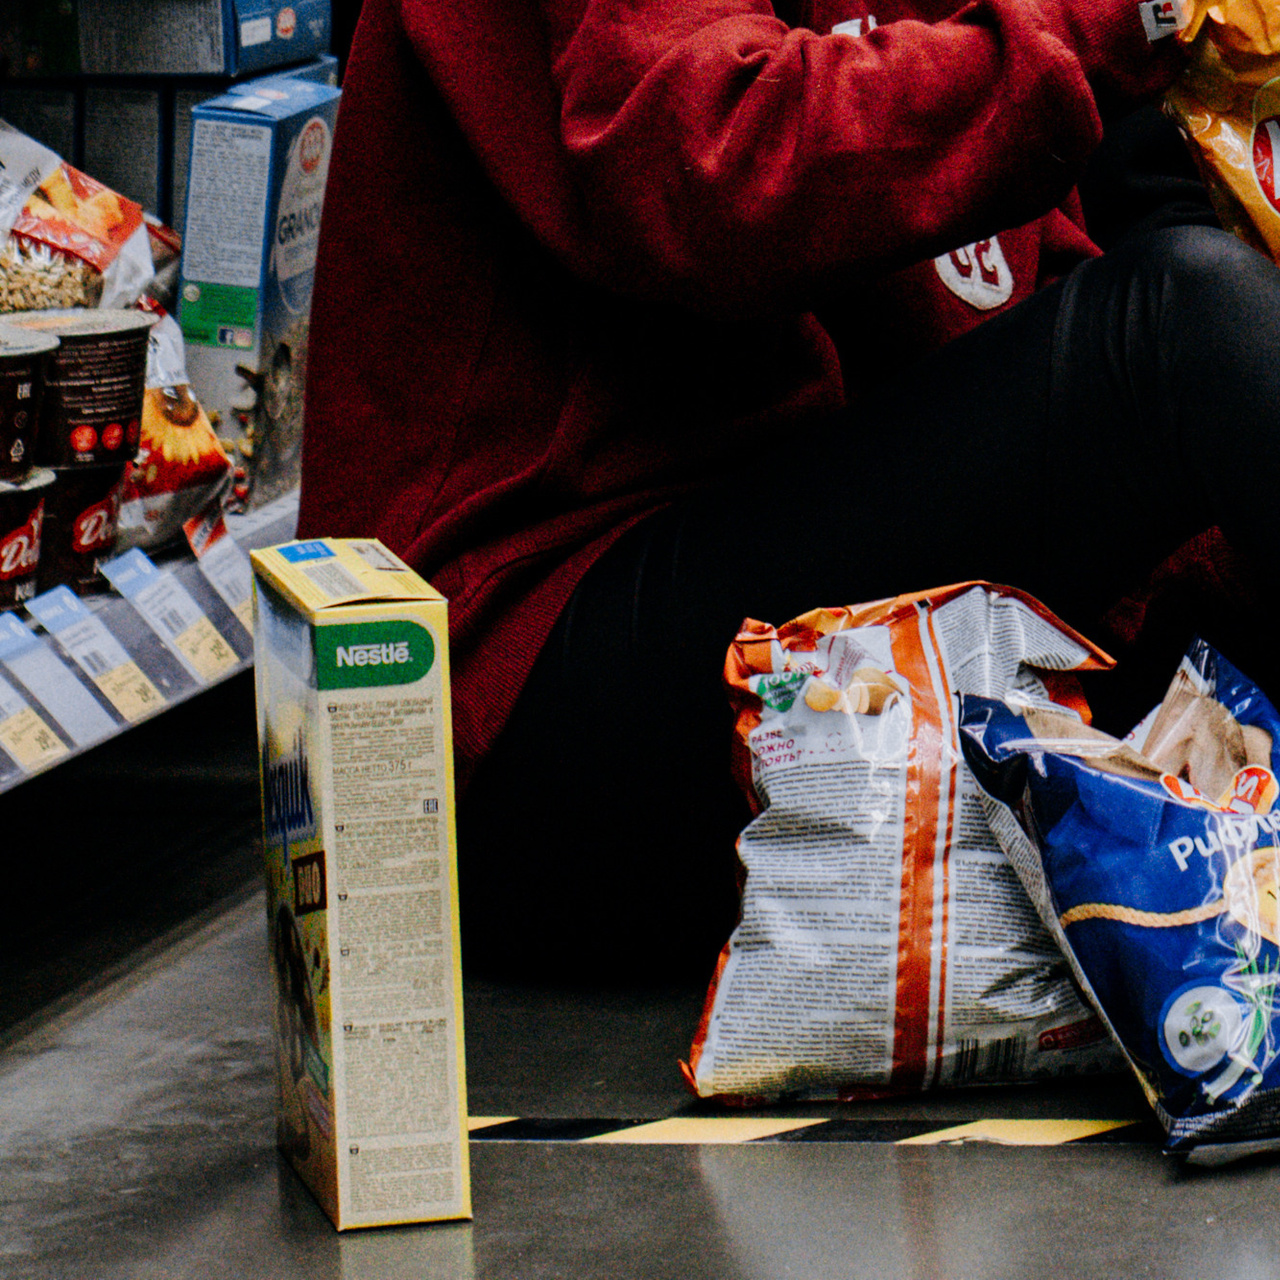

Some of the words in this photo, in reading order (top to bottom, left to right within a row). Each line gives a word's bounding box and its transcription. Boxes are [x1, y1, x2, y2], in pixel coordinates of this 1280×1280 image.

[751, 729, 784, 744] РАЗВЕ
[754, 738, 796, 758] ОЖНО
[388, 759, 406, 772] 375
